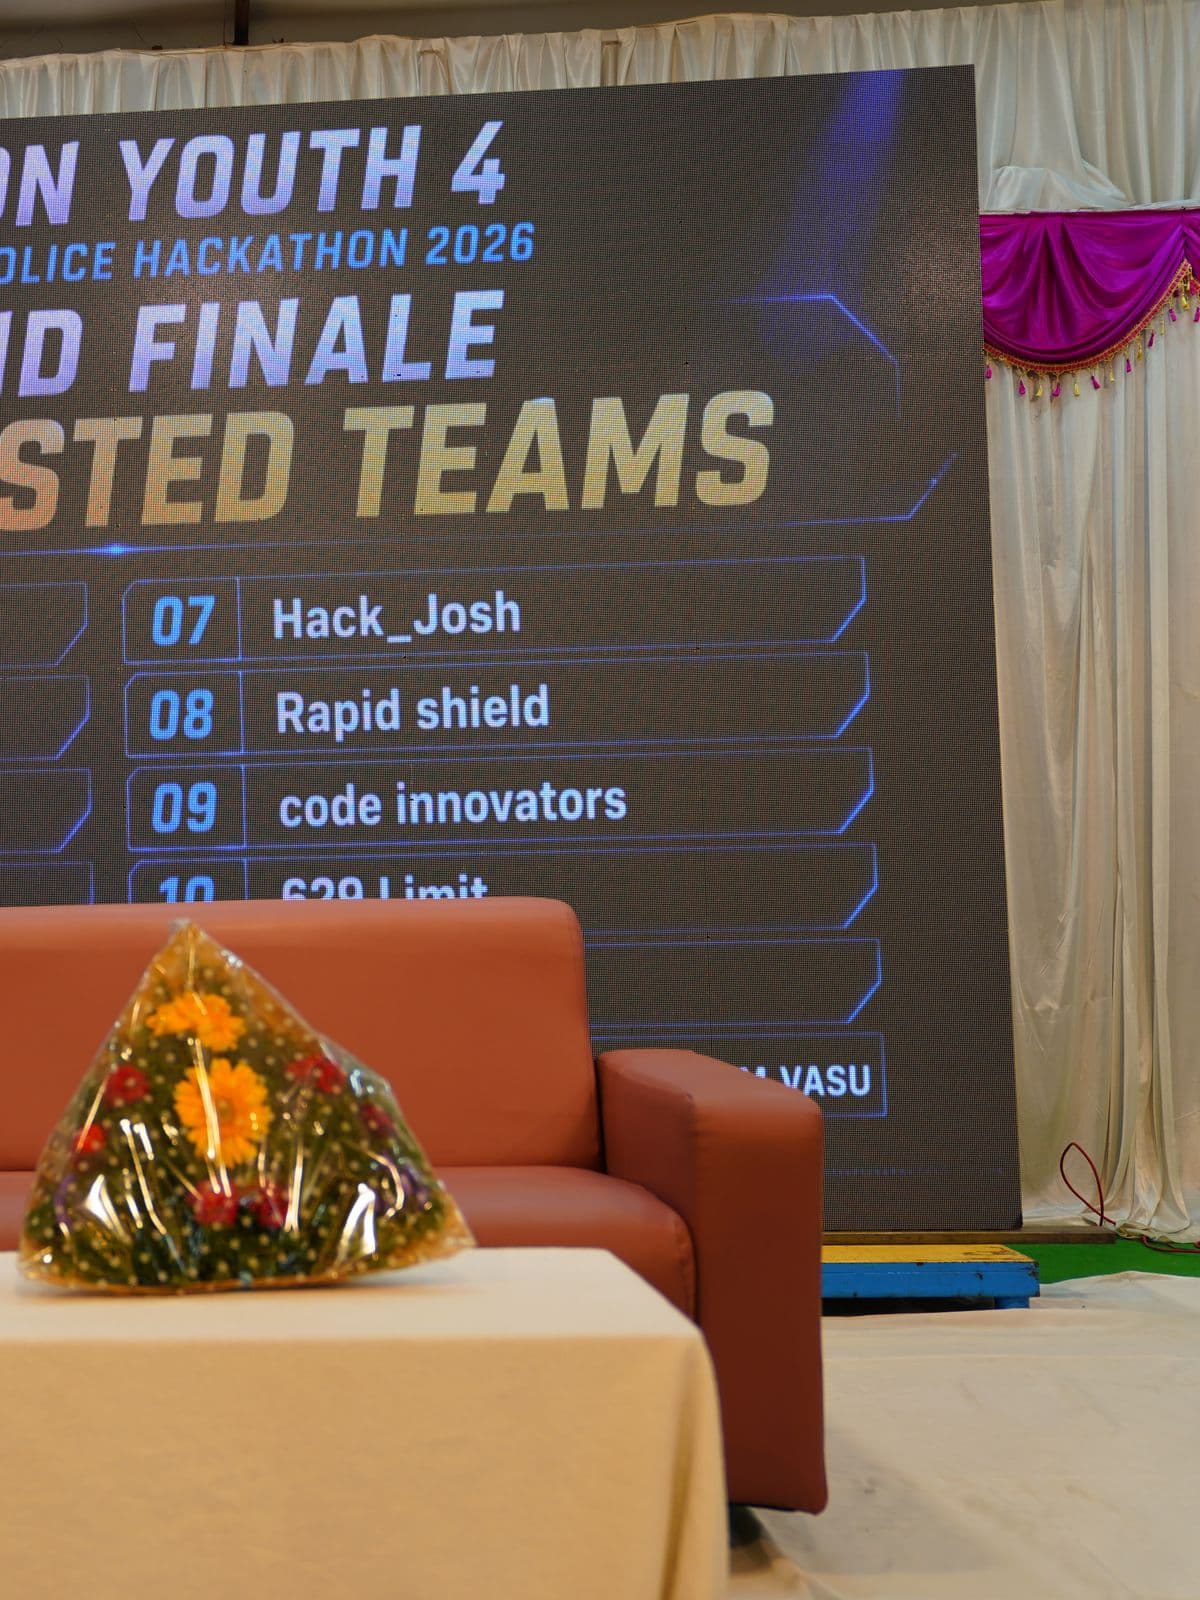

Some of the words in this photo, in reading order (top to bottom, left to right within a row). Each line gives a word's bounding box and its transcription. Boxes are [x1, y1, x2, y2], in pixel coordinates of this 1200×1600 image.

[118, 124, 422, 221] YOUTH
[451, 120, 506, 205] 4
[133, 228, 408, 278] HACKATHON
[425, 222, 535, 265] 2026
[128, 289, 505, 392] FINALE
[343, 391, 774, 518] TEAMS
[152, 595, 216, 646] 07
[273, 590, 521, 644] Hack_Josh
[149, 688, 214, 740] 08
[277, 687, 401, 743] Rapid
[416, 683, 550, 730] shield
[151, 781, 217, 833] 09
[279, 783, 382, 828] code
[396, 781, 627, 825] innovators
[779, 1064, 871, 1097] VASU
